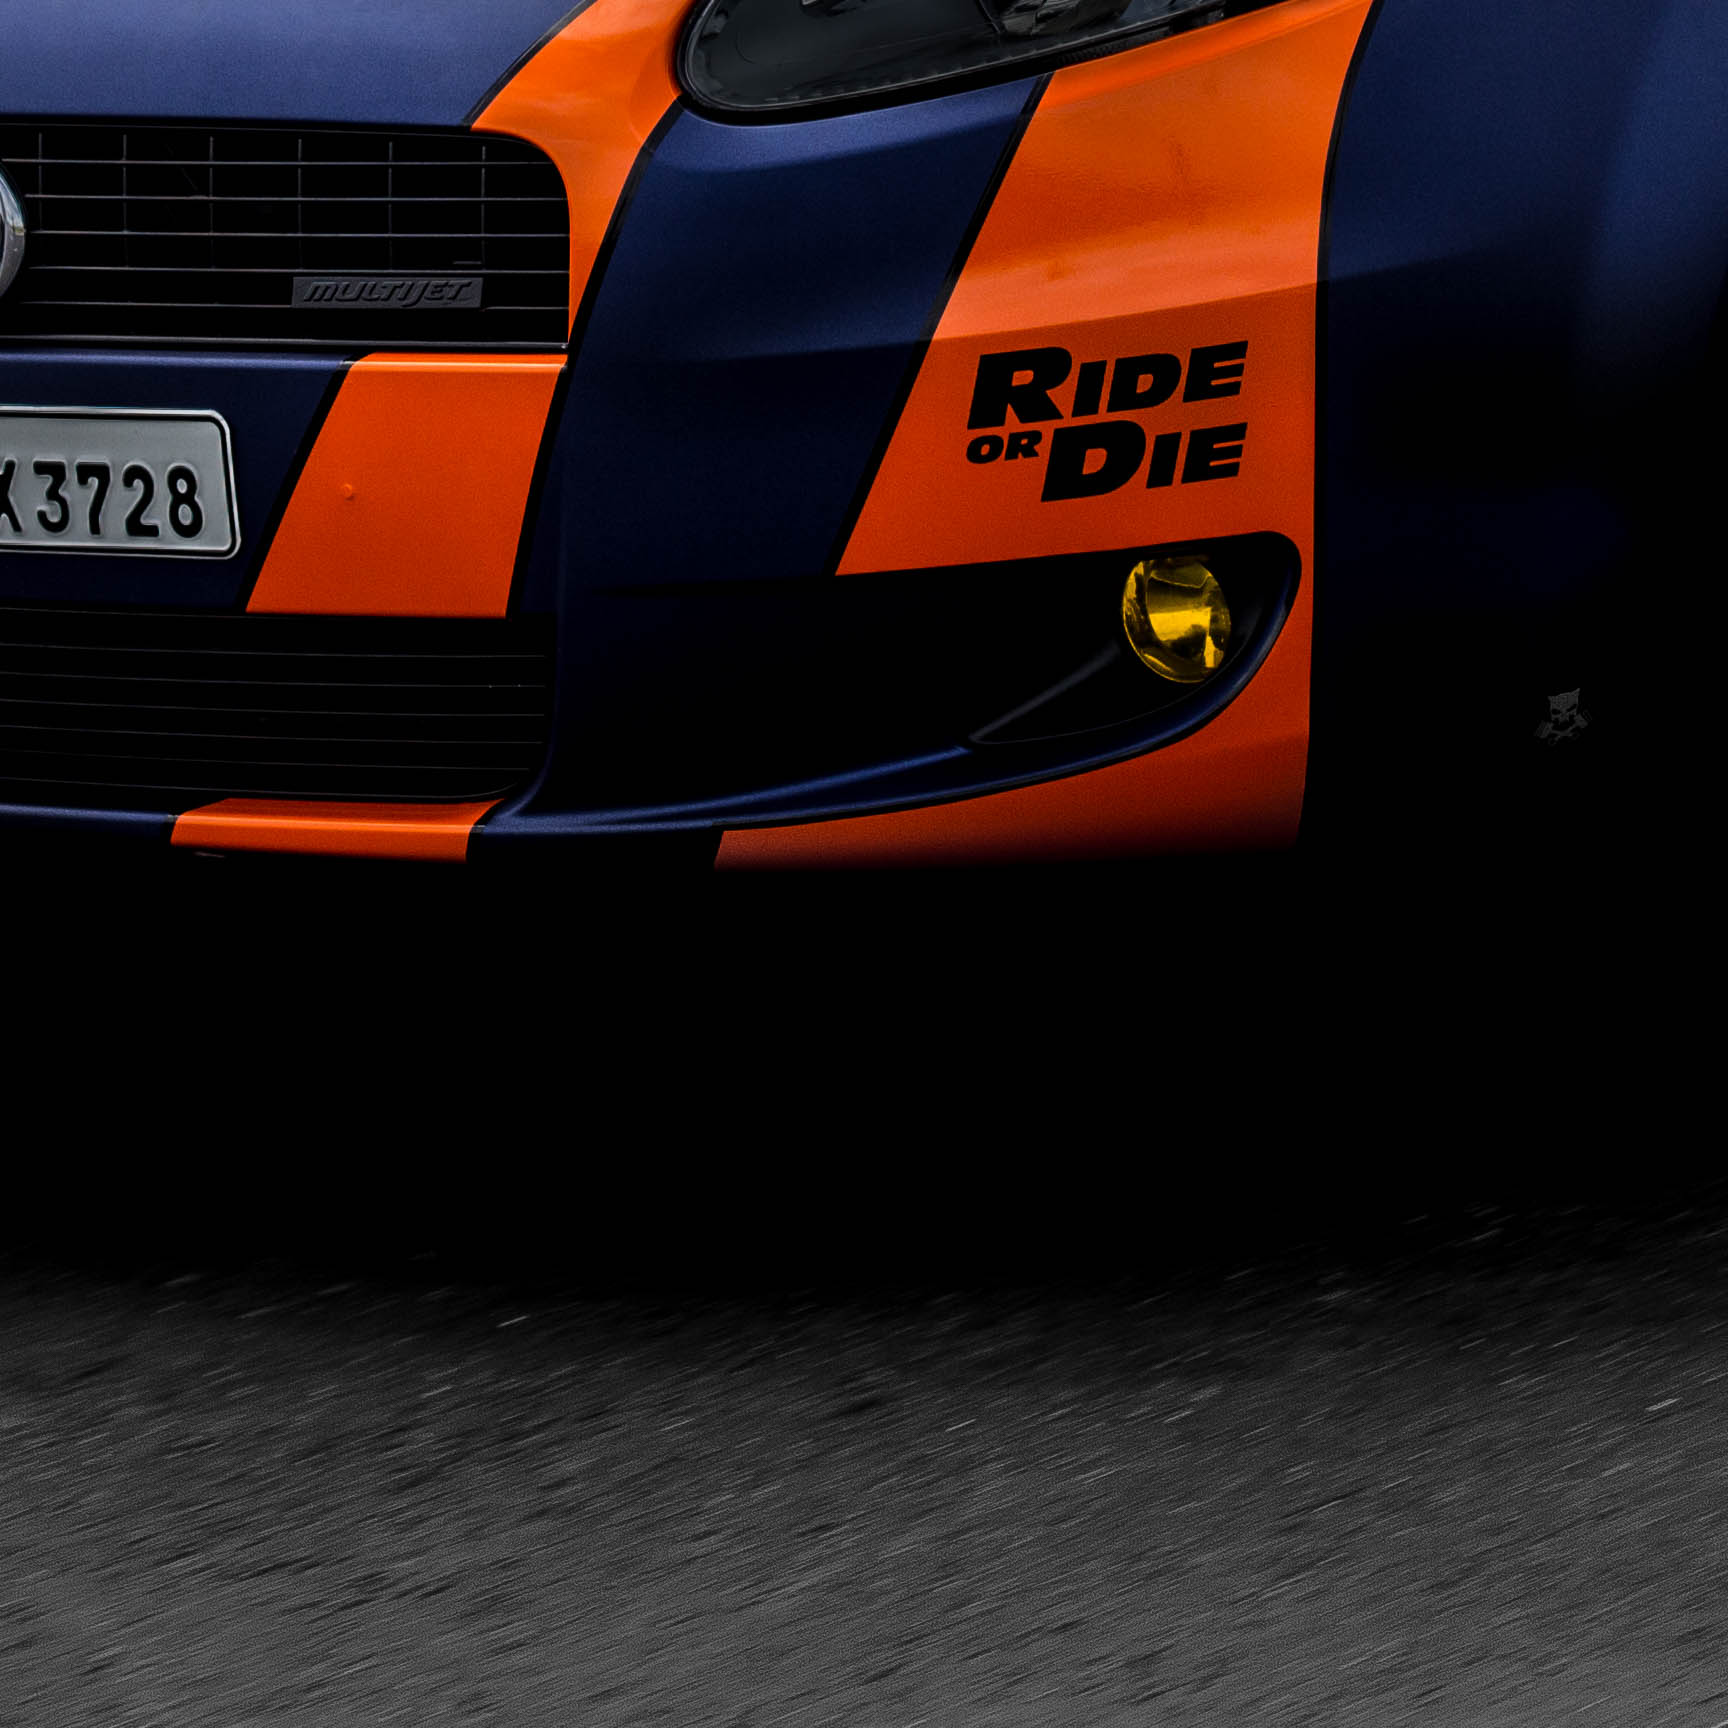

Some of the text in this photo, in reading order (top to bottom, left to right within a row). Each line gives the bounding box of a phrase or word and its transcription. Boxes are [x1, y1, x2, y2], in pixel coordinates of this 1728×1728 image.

[967, 340, 1249, 430] RIDE
[966, 419, 1249, 503] OR DIE
